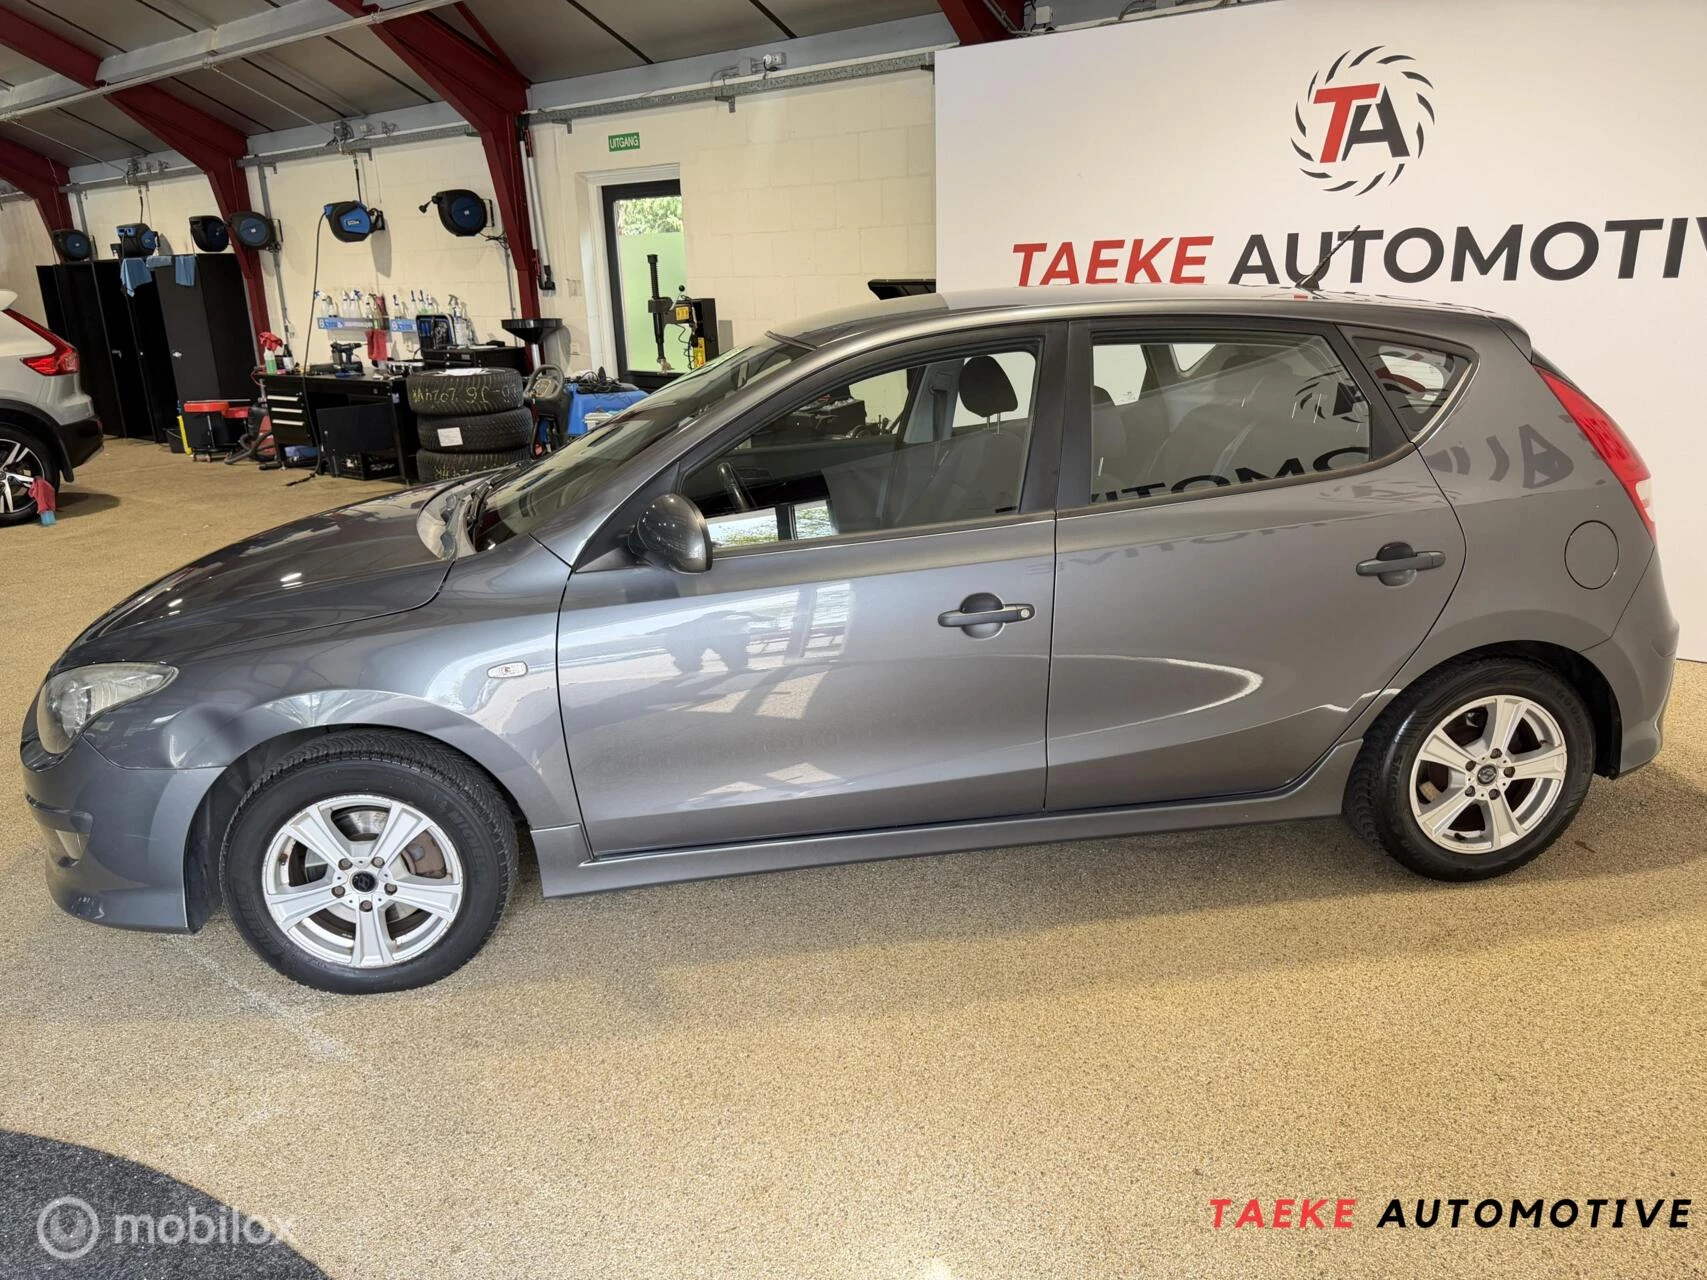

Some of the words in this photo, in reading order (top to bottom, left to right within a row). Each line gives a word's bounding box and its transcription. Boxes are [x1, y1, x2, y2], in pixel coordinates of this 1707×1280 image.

[1313, 82, 1411, 164] TA
[1012, 235, 1215, 287] TAEKE
[1227, 216, 1707, 284] AUTOMOTI
